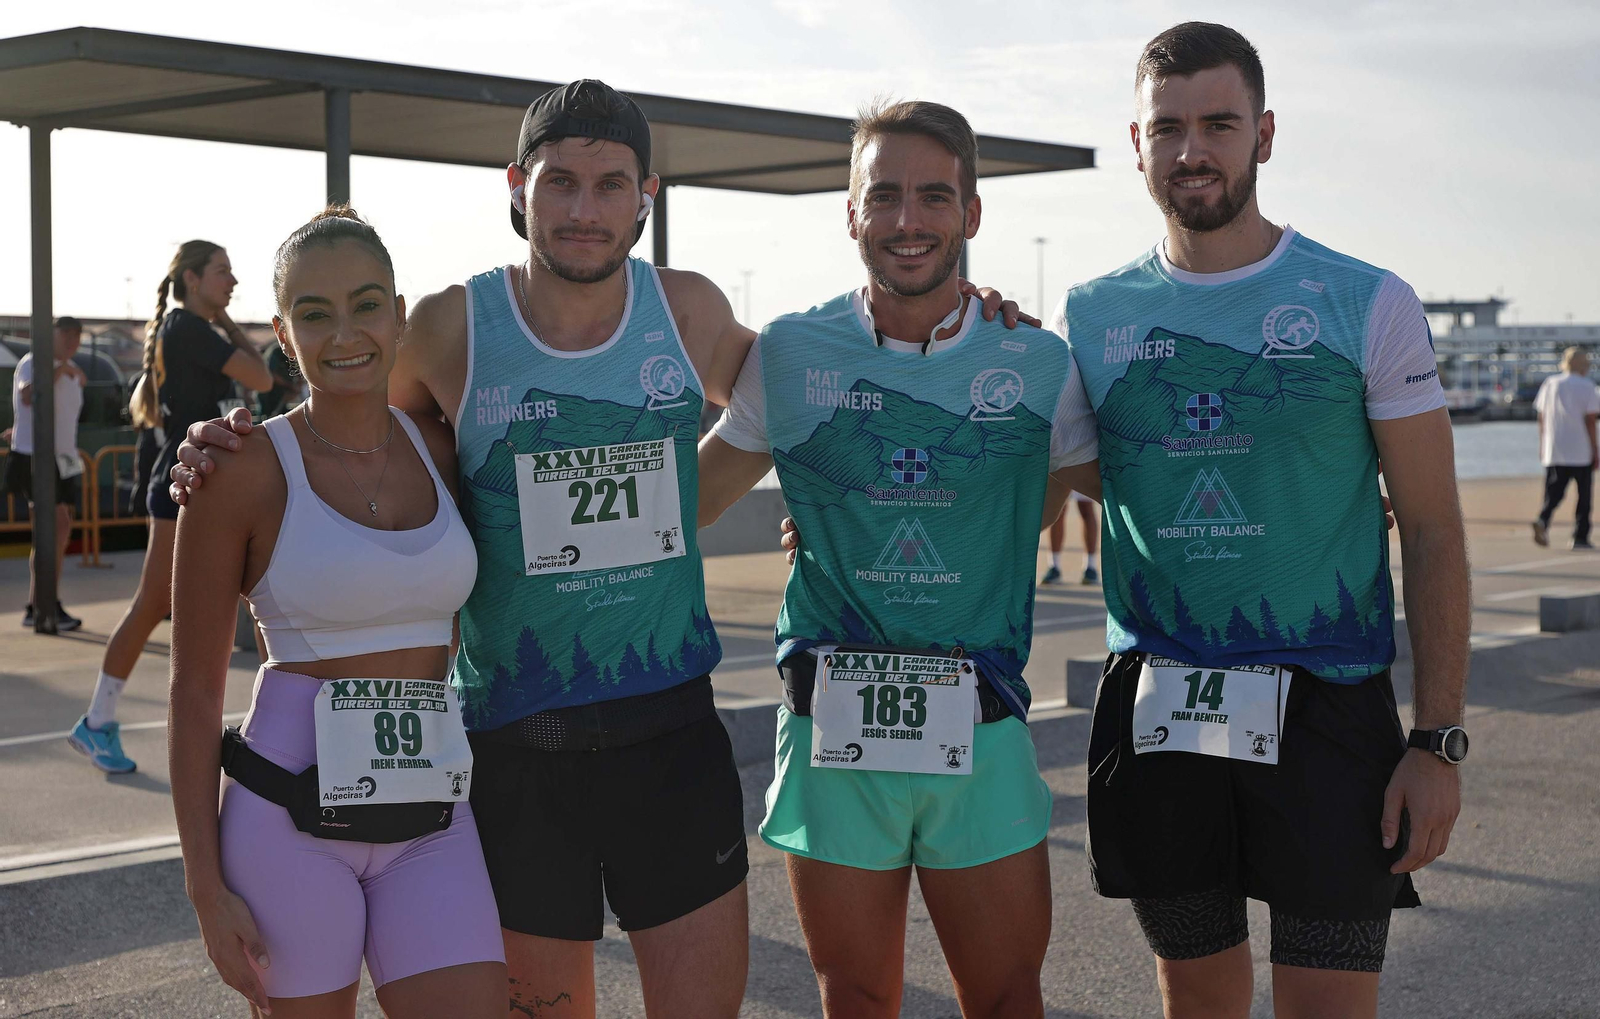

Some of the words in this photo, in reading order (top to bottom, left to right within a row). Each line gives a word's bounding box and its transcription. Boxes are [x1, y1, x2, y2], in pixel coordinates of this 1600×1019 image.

[1105, 325, 1137, 346] MAT
[1103, 339, 1175, 364] RUNNERS
[806, 368, 842, 388] MAT
[476, 386, 511, 407] MAT
[806, 386, 883, 411] RUNNERS
[476, 399, 558, 426] RUNNERS
[608, 441, 664, 454] CARRERA
[1162, 433, 1254, 451] Sarmiento
[532, 448, 607, 471] XXVI
[608, 449, 664, 462] POPULAR
[1167, 450, 1205, 458] SERVICIOS
[1208, 448, 1250, 456] SANITARIOS
[536, 469, 586, 482] VIRGEN
[593, 464, 618, 476] DEL
[626, 459, 663, 473] PILAR
[866, 484, 957, 500] Sarmiento
[568, 476, 640, 525] 221
[1157, 526, 1206, 539] MOBILITY
[1210, 524, 1266, 537] BALANCE
[528, 560, 567, 570] Algeciras
[537, 554, 558, 562] Puerto
[556, 576, 606, 593] MOBILITY
[608, 566, 654, 584] BALANCE
[856, 570, 906, 582] MOBILITY
[910, 572, 962, 584] BALANCE
[832, 654, 900, 672] XXVI
[902, 656, 959, 666] CARRERA
[902, 664, 959, 674] POPULAR
[832, 671, 879, 681] VIRGEN
[884, 673, 910, 682] DEL
[916, 675, 958, 685] PILAR
[330, 680, 403, 698] XXVI
[404, 682, 446, 692] CARRERA
[1184, 670, 1226, 710] 14
[404, 690, 445, 700] POPULAR
[334, 700, 382, 709] VIRGEN
[388, 700, 412, 710] DEL
[418, 701, 446, 712] PILAR
[857, 684, 927, 728] 183
[1171, 711, 1192, 722] FRAN
[1193, 712, 1228, 724] BENITEZ
[374, 712, 422, 756] 89
[861, 727, 888, 738] JESÚS
[890, 728, 923, 740] SEDEÑO
[371, 759, 396, 770] IRENE
[397, 759, 434, 769] HERRERA
[813, 754, 849, 763] Algeciras
[322, 792, 363, 802] Algeciras
